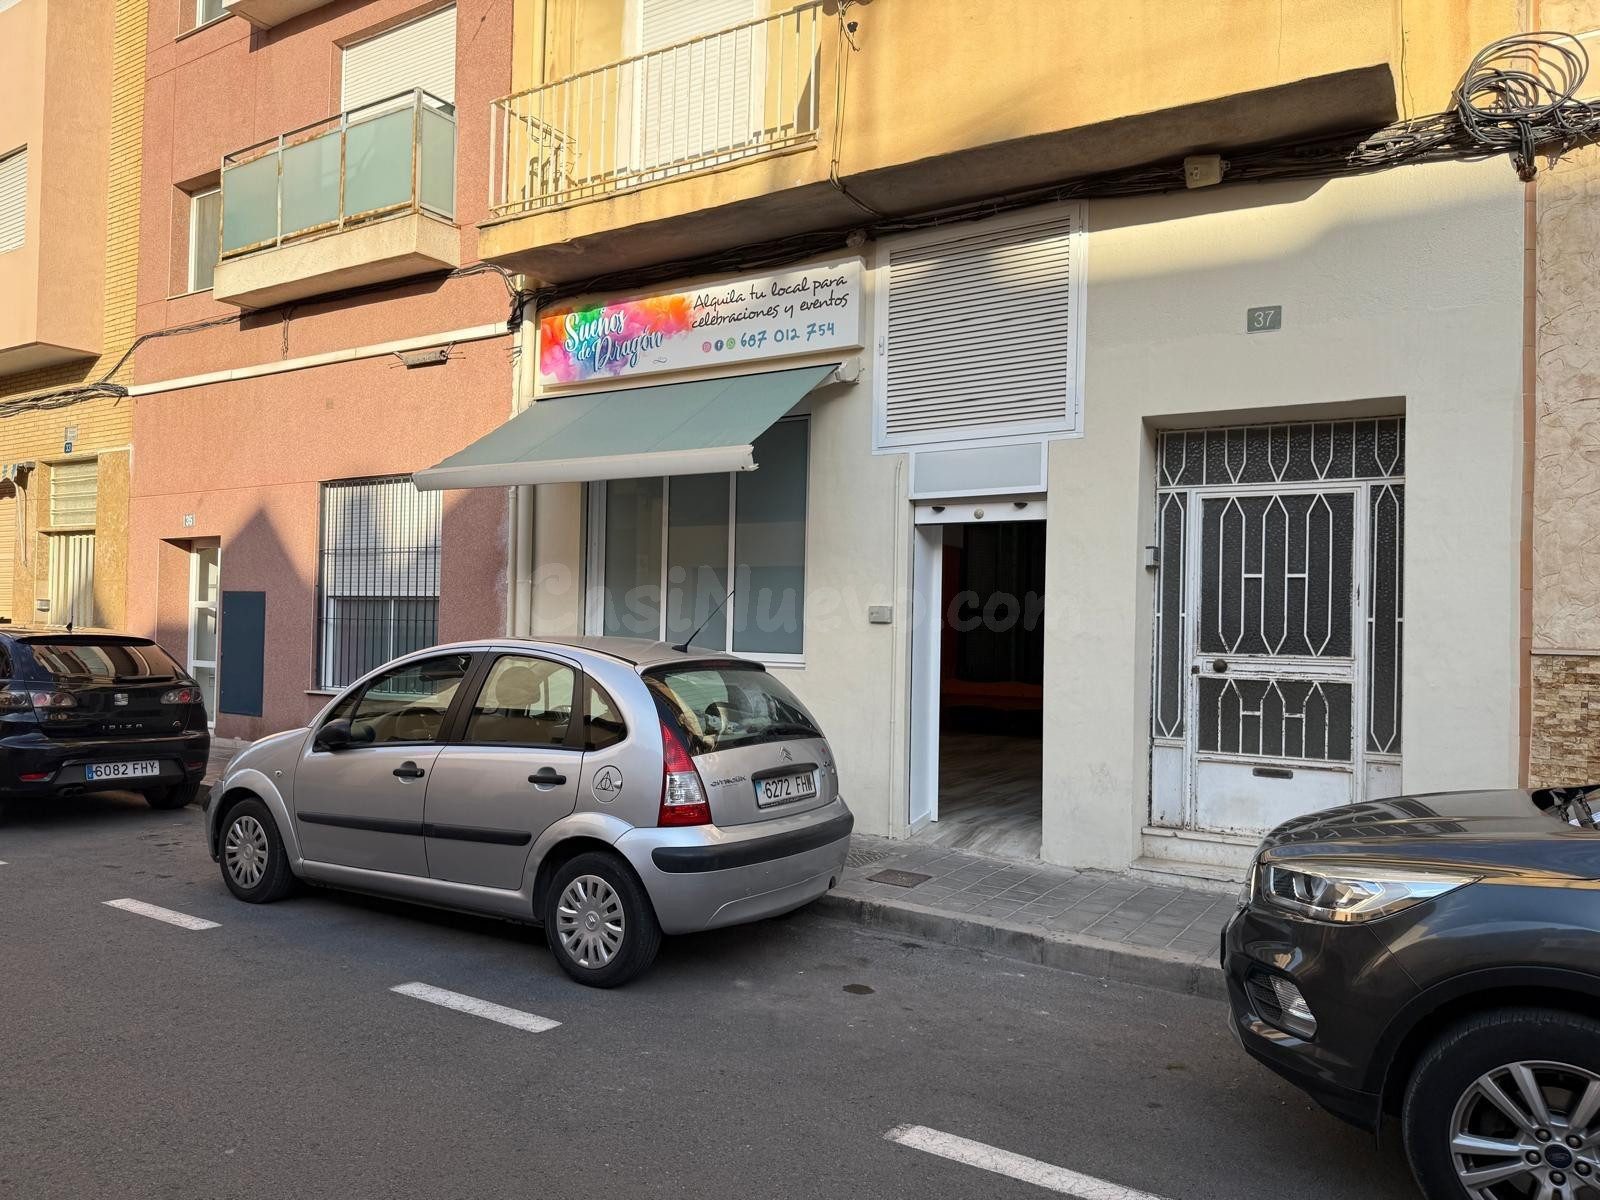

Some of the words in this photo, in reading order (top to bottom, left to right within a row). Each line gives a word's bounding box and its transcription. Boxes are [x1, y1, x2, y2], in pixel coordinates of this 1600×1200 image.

[693, 289, 746, 311] Alquila
[750, 284, 766, 300] tu
[771, 277, 810, 297] local
[813, 275, 847, 296] para
[691, 304, 778, 329] celebraciones
[784, 305, 794, 318] y
[800, 289, 849, 312] eventos
[1254, 310, 1275, 328] 37
[740, 330, 767, 348] 687
[774, 328, 800, 343] 012
[806, 322, 835, 342] 754
[577, 341, 592, 361] de
[95, 764, 128, 777] 6082
[132, 761, 155, 775] FHY
[765, 778, 791, 799] 6272
